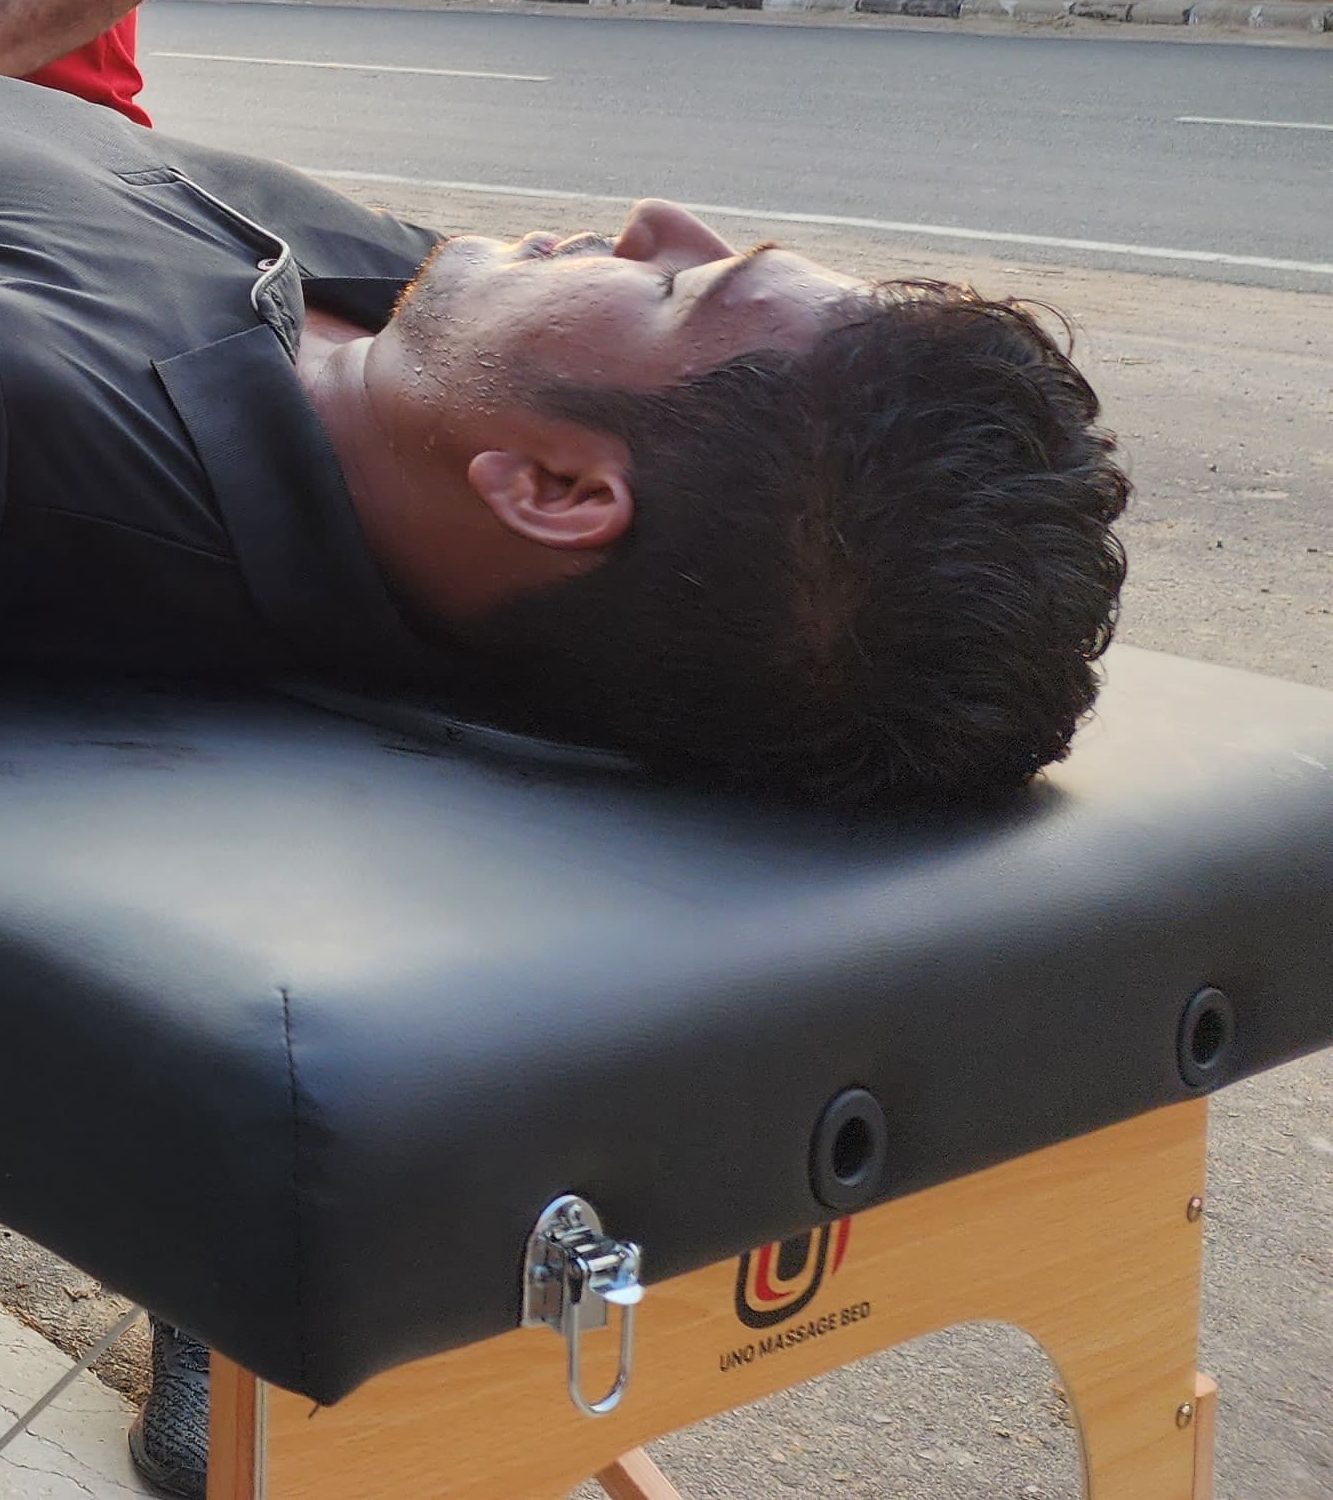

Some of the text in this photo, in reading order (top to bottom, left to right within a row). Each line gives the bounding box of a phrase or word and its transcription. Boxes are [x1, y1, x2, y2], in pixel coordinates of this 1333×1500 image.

[719, 1300, 871, 1373] UNO MASSAGE BED
